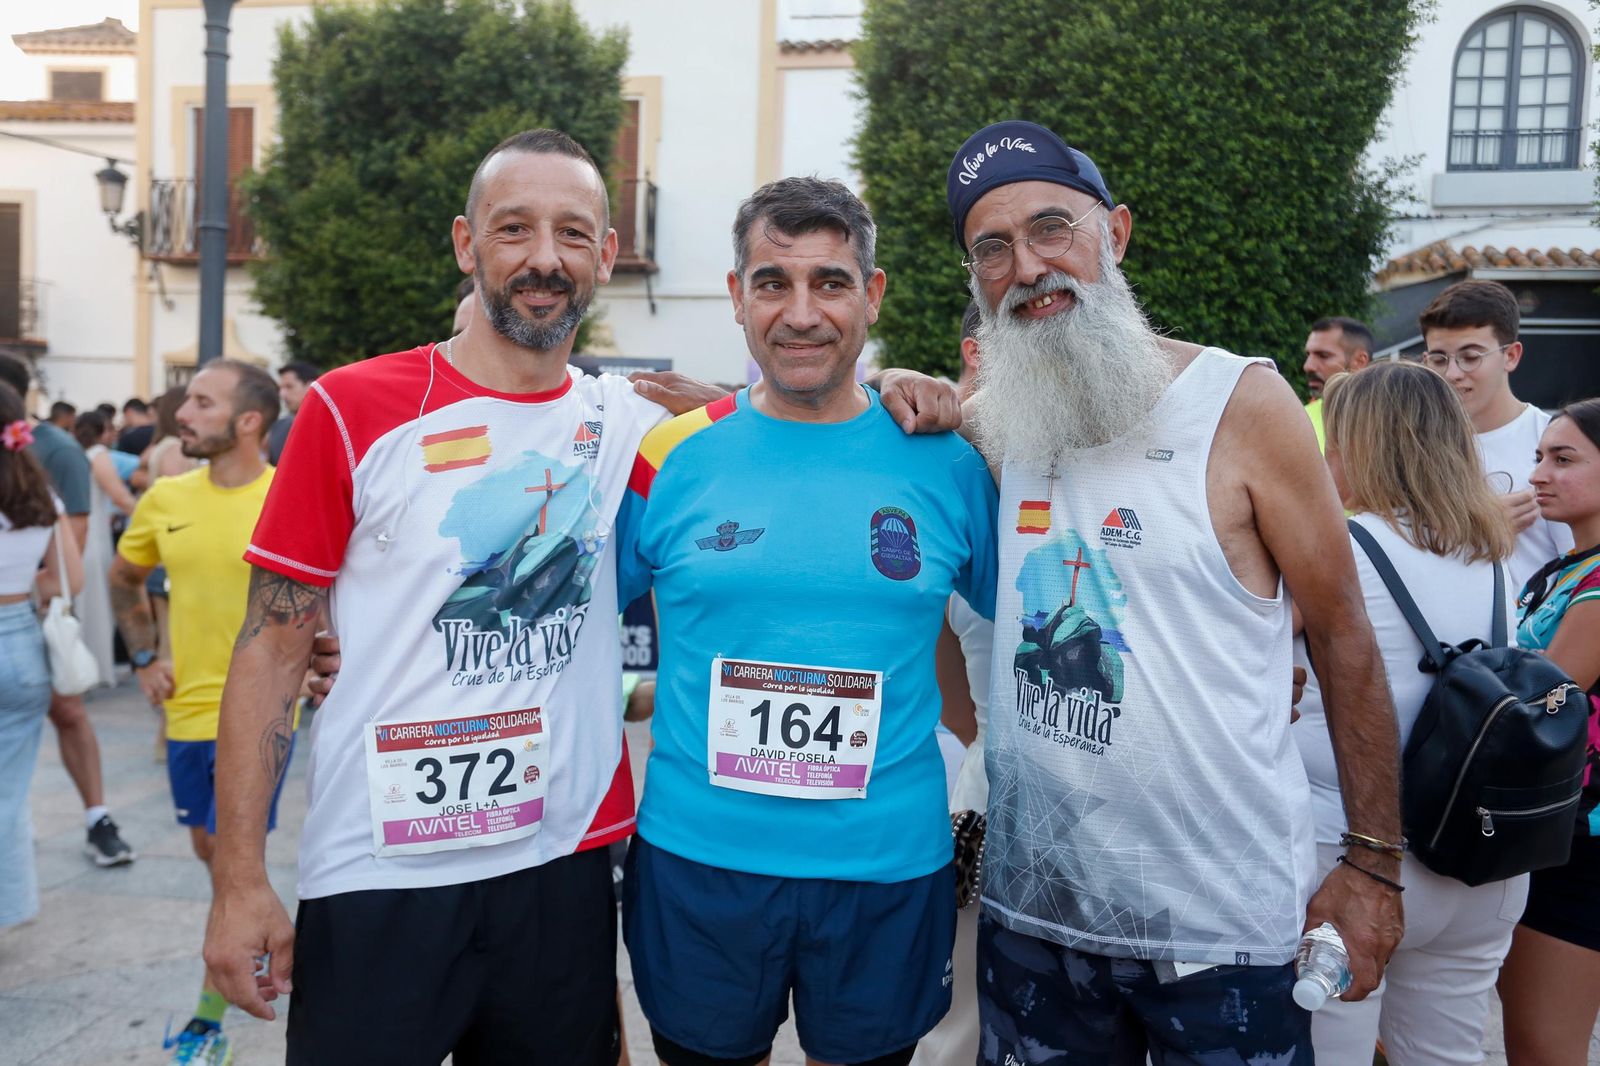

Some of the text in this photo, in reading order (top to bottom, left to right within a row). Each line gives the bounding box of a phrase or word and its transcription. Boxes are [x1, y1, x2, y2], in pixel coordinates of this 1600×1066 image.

[959, 137, 1037, 185] Vive la Vida
[1100, 527, 1142, 541] ADEM-C.G.
[440, 619, 501, 672] Vive
[505, 617, 533, 668] la
[452, 672, 485, 687] Cruz
[487, 665, 505, 683] de
[510, 666, 522, 682] la
[734, 665, 773, 681] CARRERA
[774, 669, 827, 686] NOCTURNA
[828, 674, 873, 690] SOLIDARIA
[762, 682, 783, 690] corre
[784, 684, 797, 693] por
[806, 686, 835, 696] igualdad
[1016, 668, 1120, 746] Vive la vida
[389, 725, 434, 740] CARRERA
[434, 718, 490, 736] NOCTURNA
[489, 711, 538, 731] SOLIDARIA
[750, 699, 843, 751] 164
[424, 731, 500, 747] corre por la igualdad
[1033, 720, 1041, 735] de
[1043, 723, 1050, 739] la
[1053, 729, 1104, 757] Esperanza
[750, 747, 836, 764] DAVID FOSELA
[414, 748, 517, 804] 372
[734, 757, 801, 779] AVATEL
[775, 777, 801, 785] TELECOM
[439, 799, 500, 817] JOSE L+A
[407, 815, 482, 837] AVATEL
[454, 829, 482, 838] TELECOM
